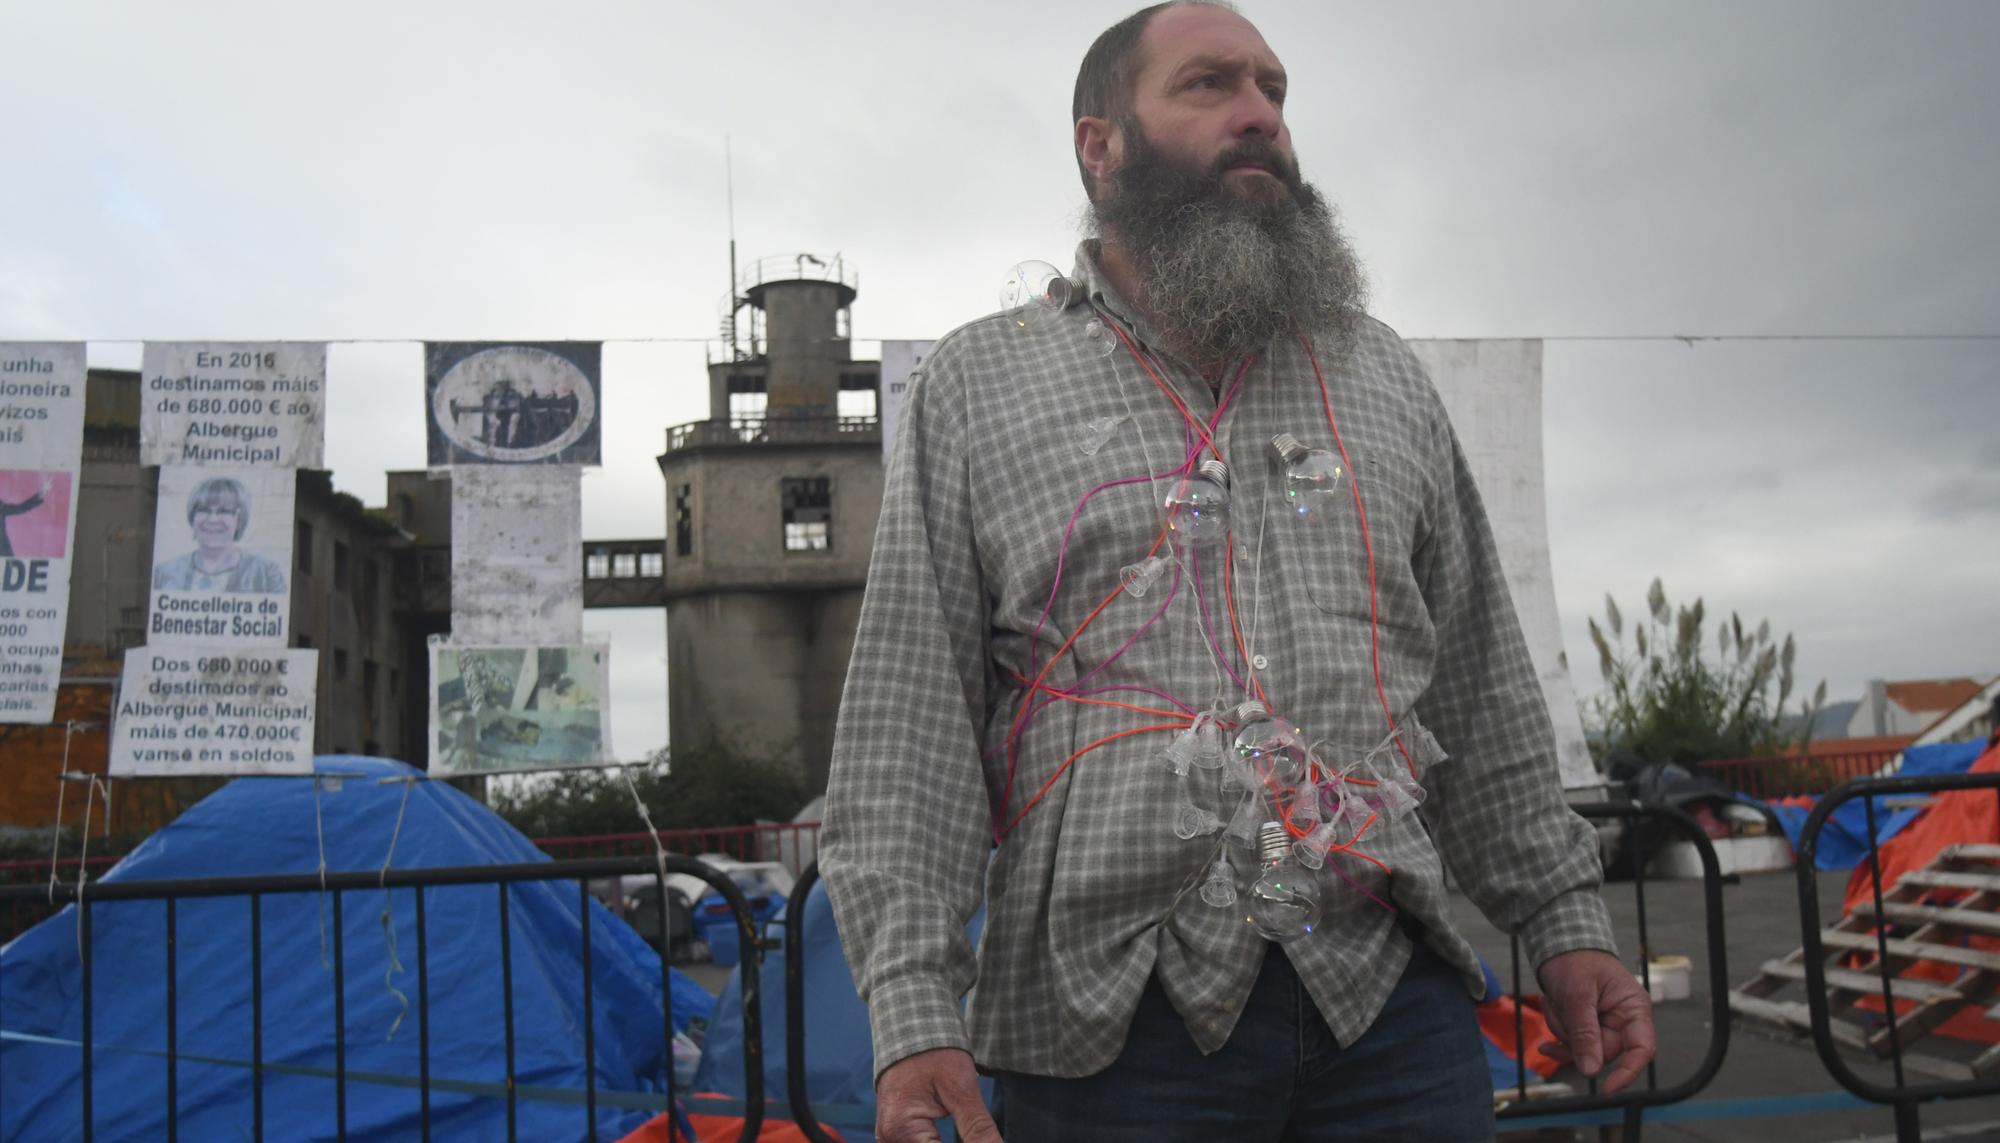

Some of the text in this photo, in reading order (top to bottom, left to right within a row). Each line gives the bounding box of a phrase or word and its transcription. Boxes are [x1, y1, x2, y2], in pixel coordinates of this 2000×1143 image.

[3, 358, 53, 373] unha
[197, 352, 276, 369] En 2016
[151, 374, 320, 393] destinamos máis
[157, 398, 310, 416] de 680.000 € ao
[186, 422, 278, 441] Albergue
[182, 445, 280, 463] Municipal
[2, 560, 49, 592] DE
[26, 607, 57, 619] con
[158, 594, 278, 614] Concelleira de
[152, 613, 282, 637] Benestar Social
[8, 645, 59, 658] ocupa
[151, 656, 190, 673] Dos
[120, 701, 313, 721] Albergue Municipal,
[129, 723, 177, 739] máis
[184, 724, 208, 739] de
[229, 748, 295, 762] soldos
